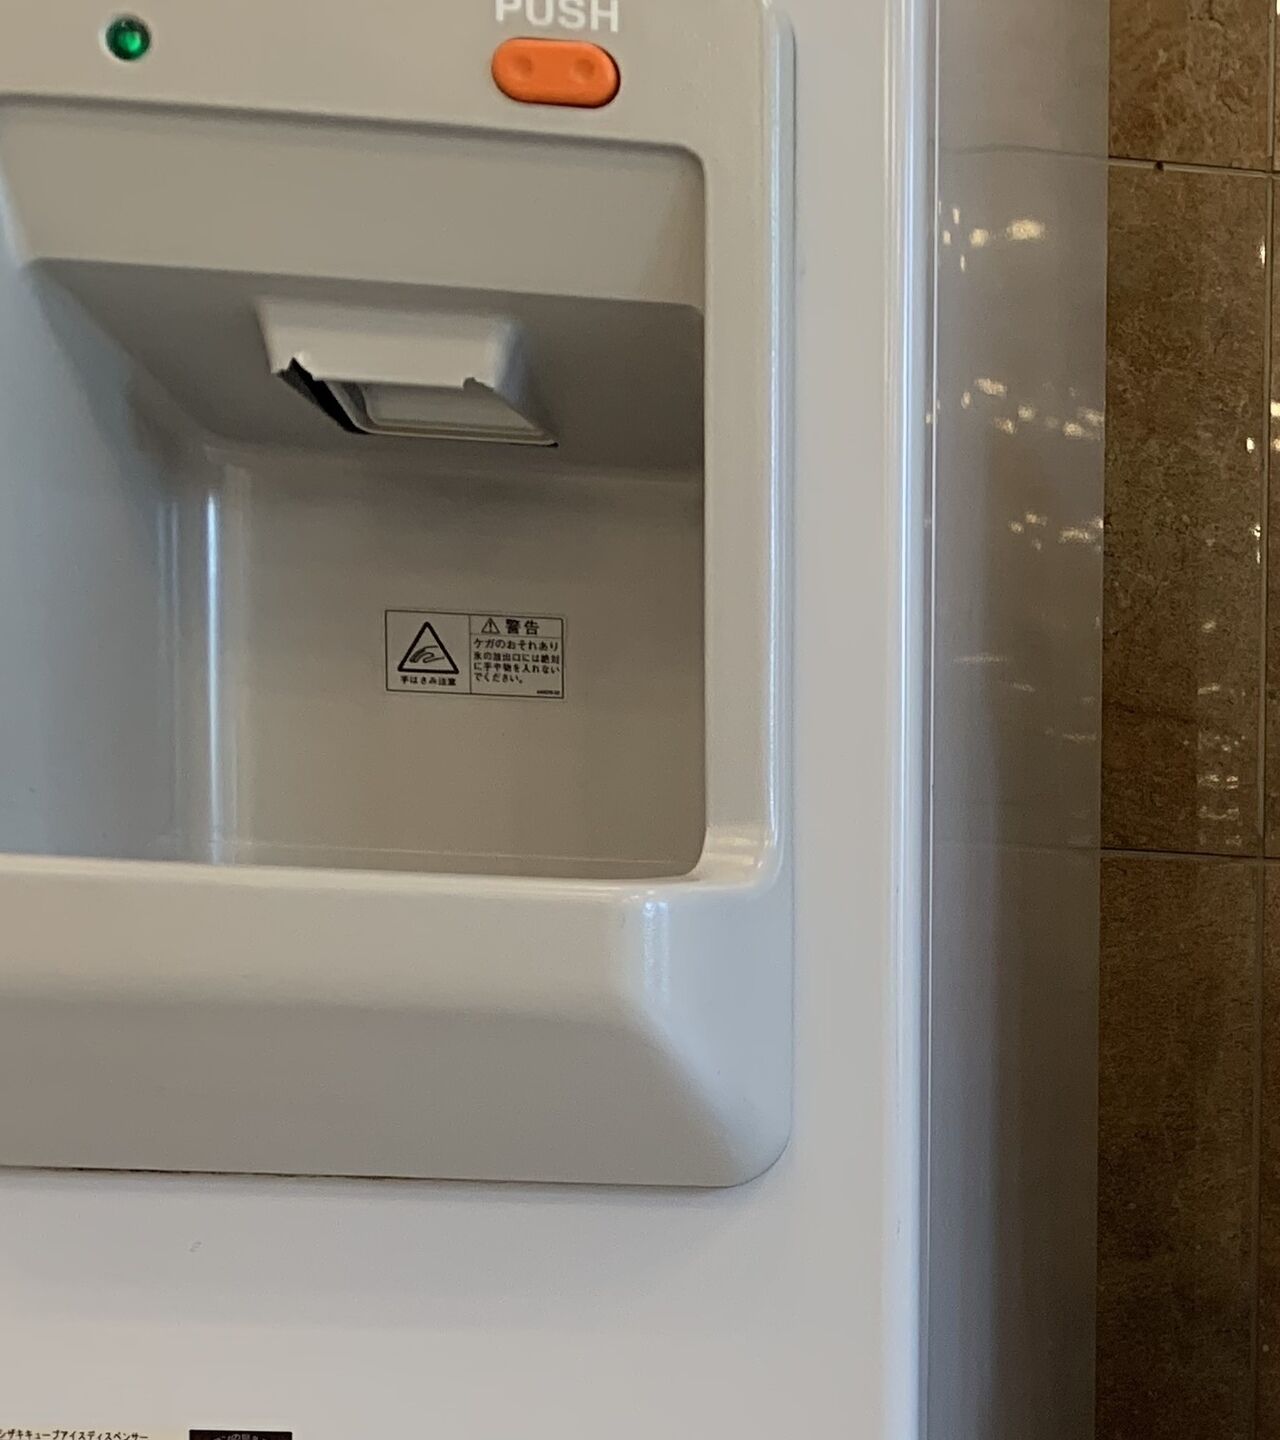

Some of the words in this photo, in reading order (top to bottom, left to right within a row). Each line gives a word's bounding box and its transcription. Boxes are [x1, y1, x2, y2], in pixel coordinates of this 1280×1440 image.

[495, 0, 618, 32] PUSH
[505, 618, 540, 635] 警告
[473, 637, 558, 652] ケガのおそれあり
[473, 673, 524, 684] でください。
